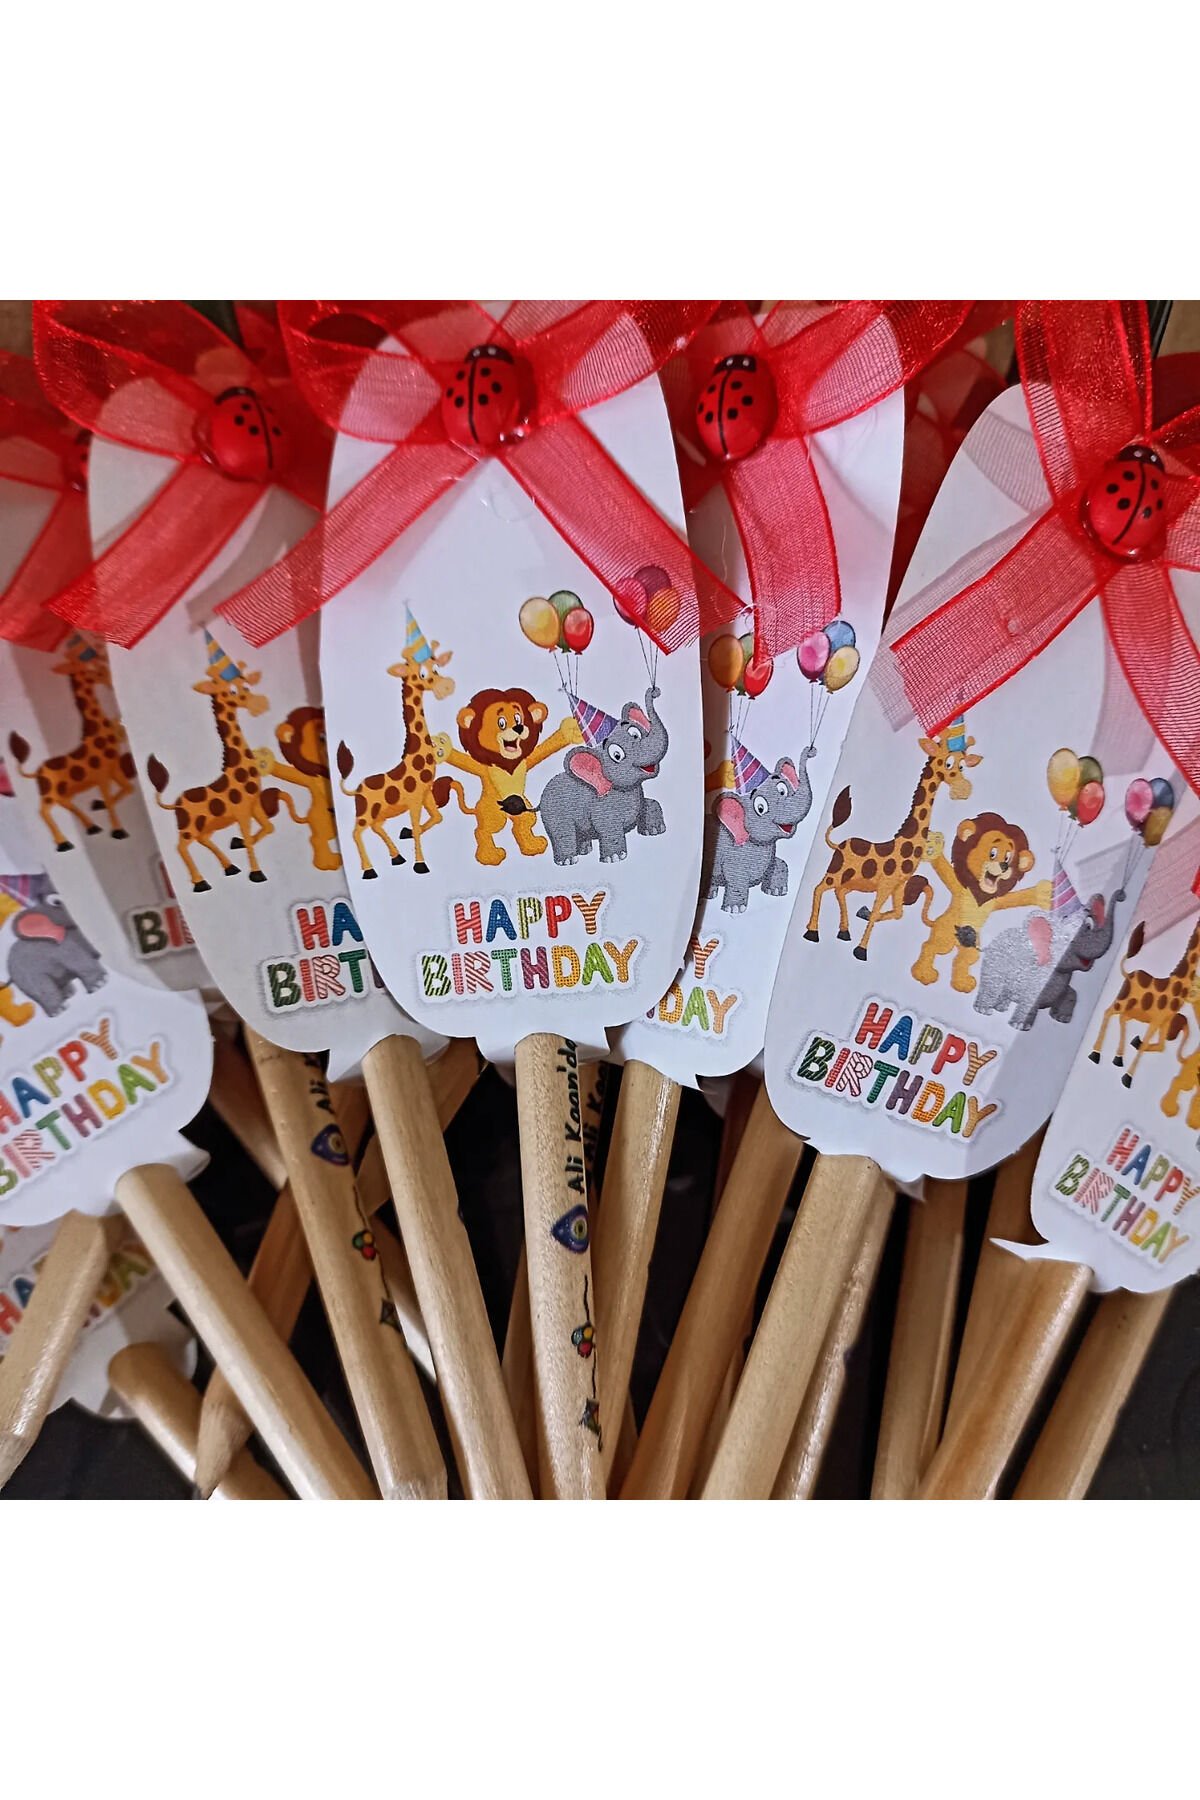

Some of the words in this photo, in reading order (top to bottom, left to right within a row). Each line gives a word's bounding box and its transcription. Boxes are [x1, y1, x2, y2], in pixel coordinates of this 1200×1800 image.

[132, 908, 195, 954] BI
[454, 890, 606, 944] HAPPY
[267, 948, 385, 1008] BIRT
[421, 939, 639, 997] BIRTHDAY
[646, 983, 738, 1034] DAY
[855, 1002, 998, 1086] HAPPY
[797, 1036, 998, 1138] BIRTHDAY
[565, 1155, 585, 1195] Ali
[1106, 1128, 1200, 1216] HAPPY
[1054, 1154, 1190, 1263] BIRTHDAY
